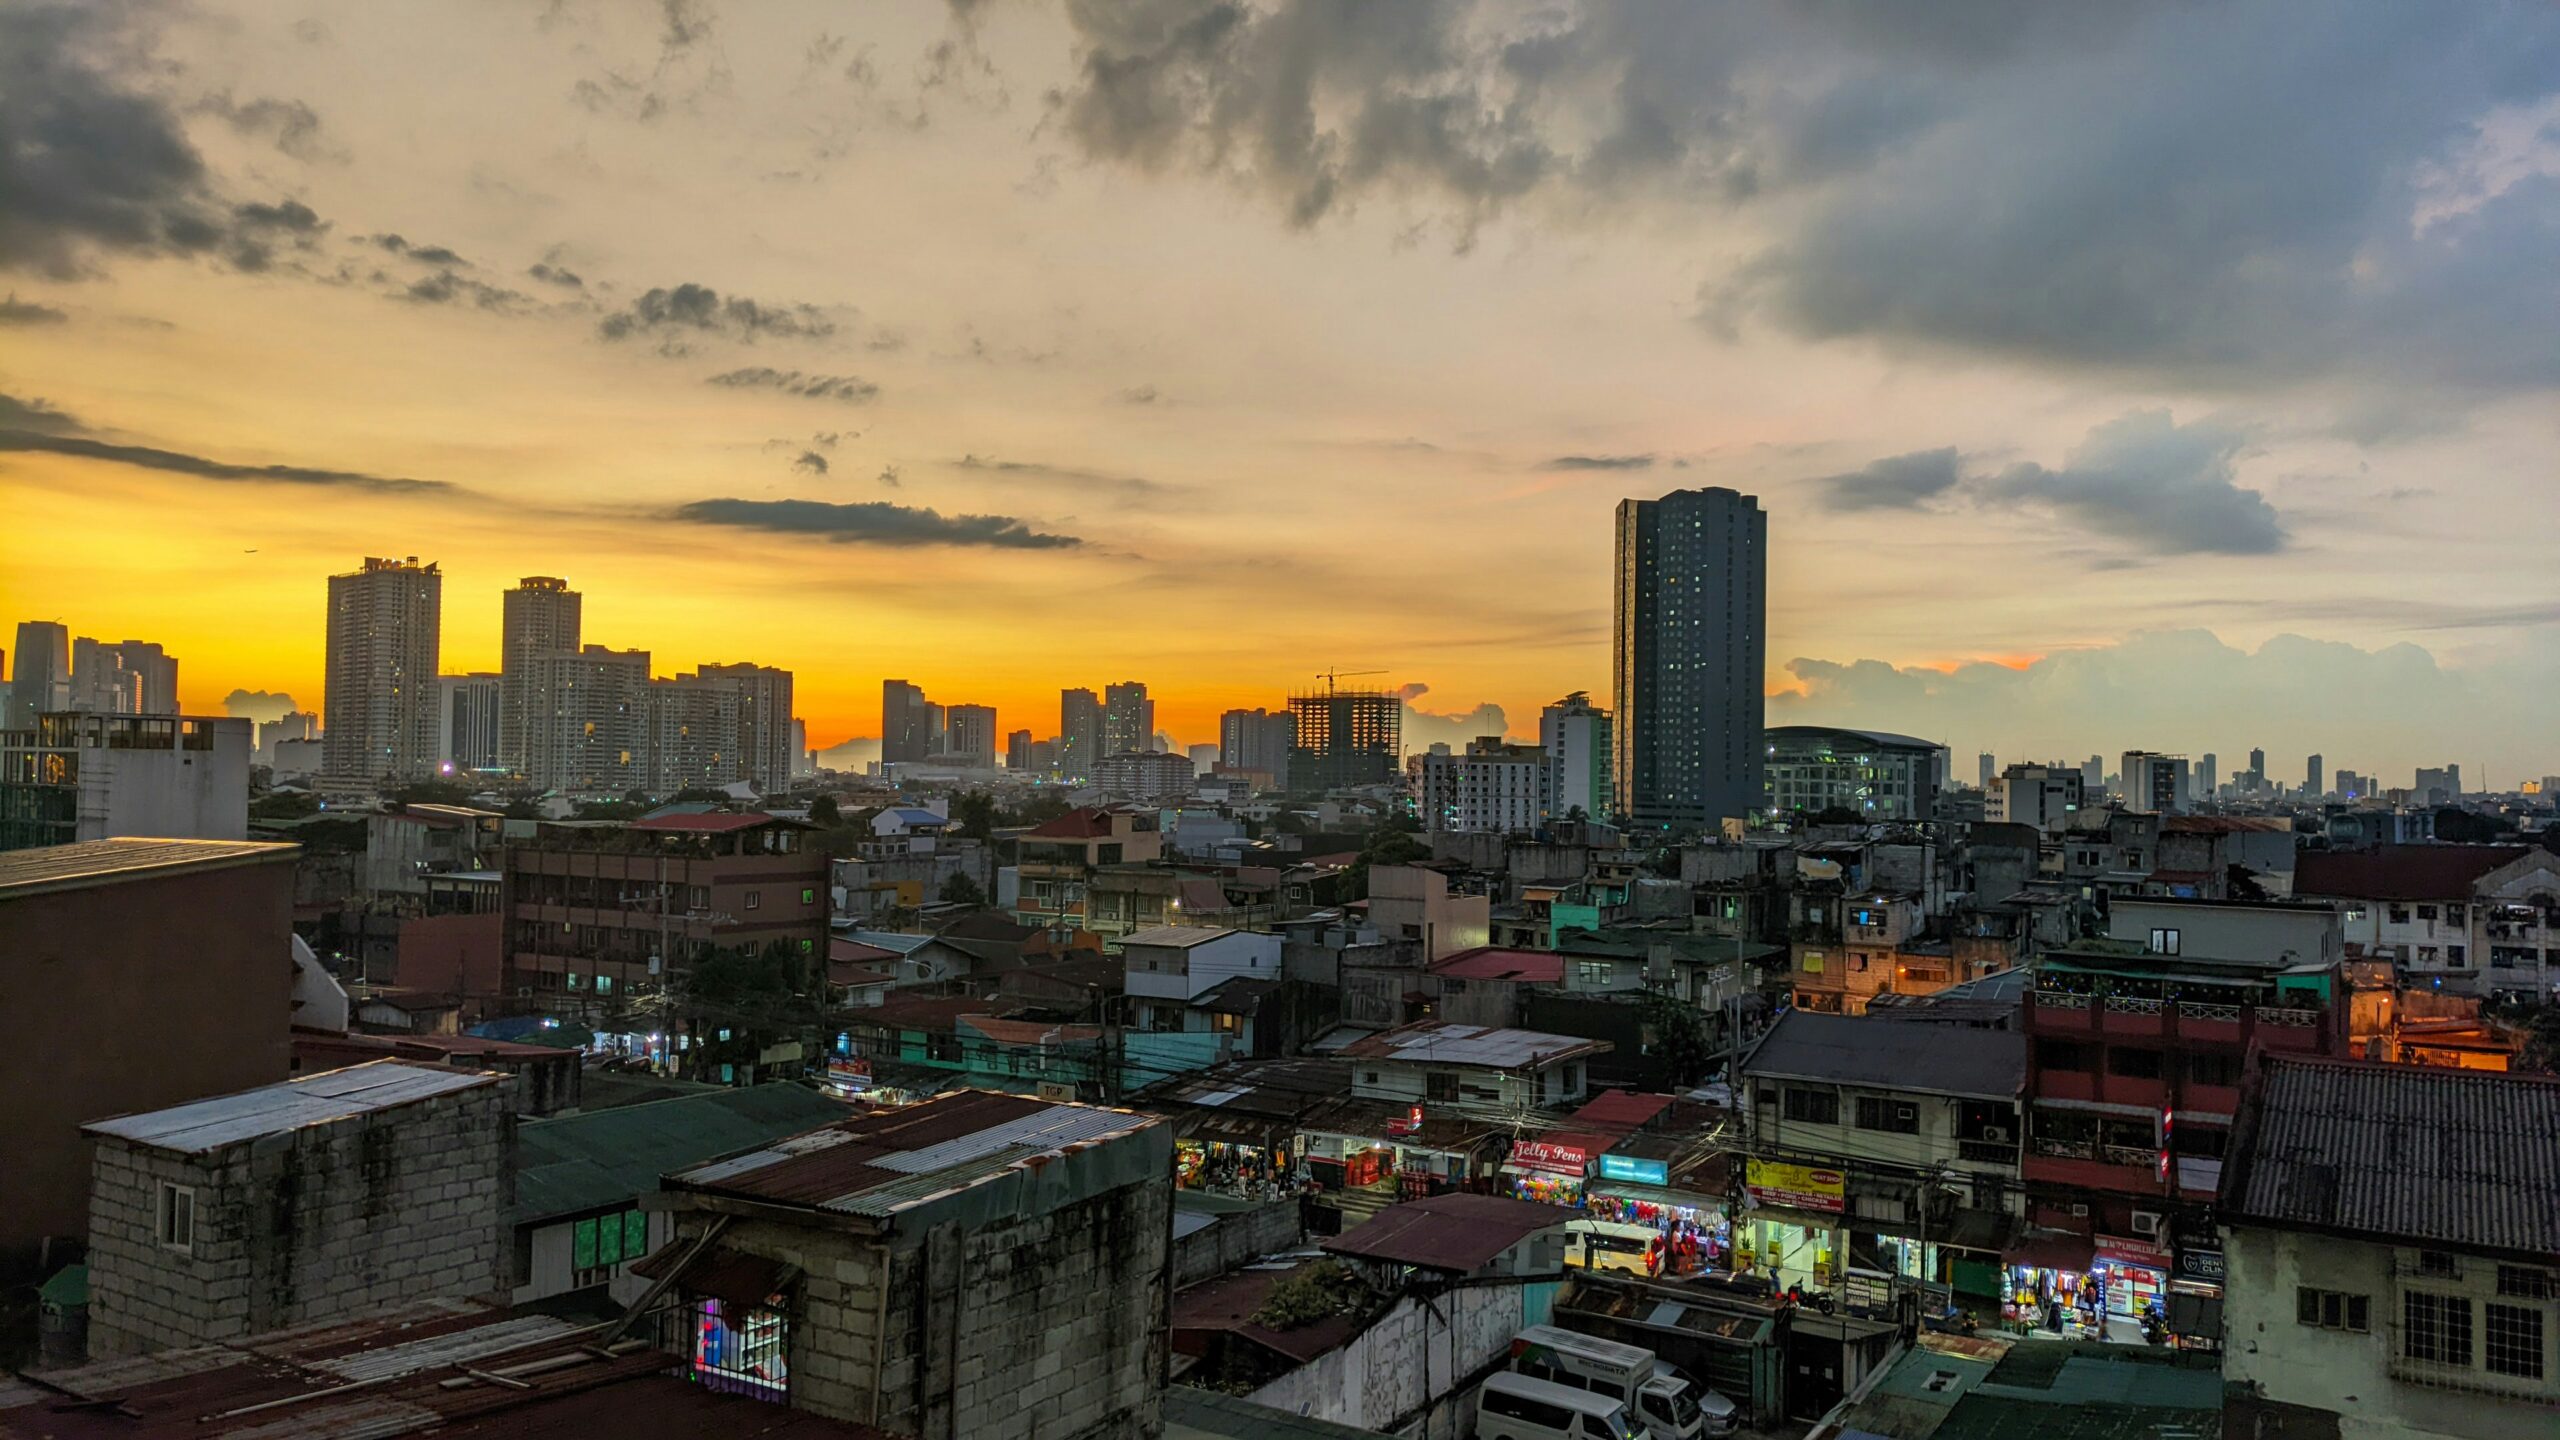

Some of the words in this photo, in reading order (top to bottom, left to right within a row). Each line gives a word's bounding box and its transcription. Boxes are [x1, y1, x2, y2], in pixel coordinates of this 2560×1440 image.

[829, 1056, 843, 1065] DITO
[1044, 1085, 1063, 1097] TGP
[1516, 1141, 1549, 1161] Jelly
[1552, 1146, 1582, 1163] Pens
[1801, 1196, 1828, 1204] CHICKEN
